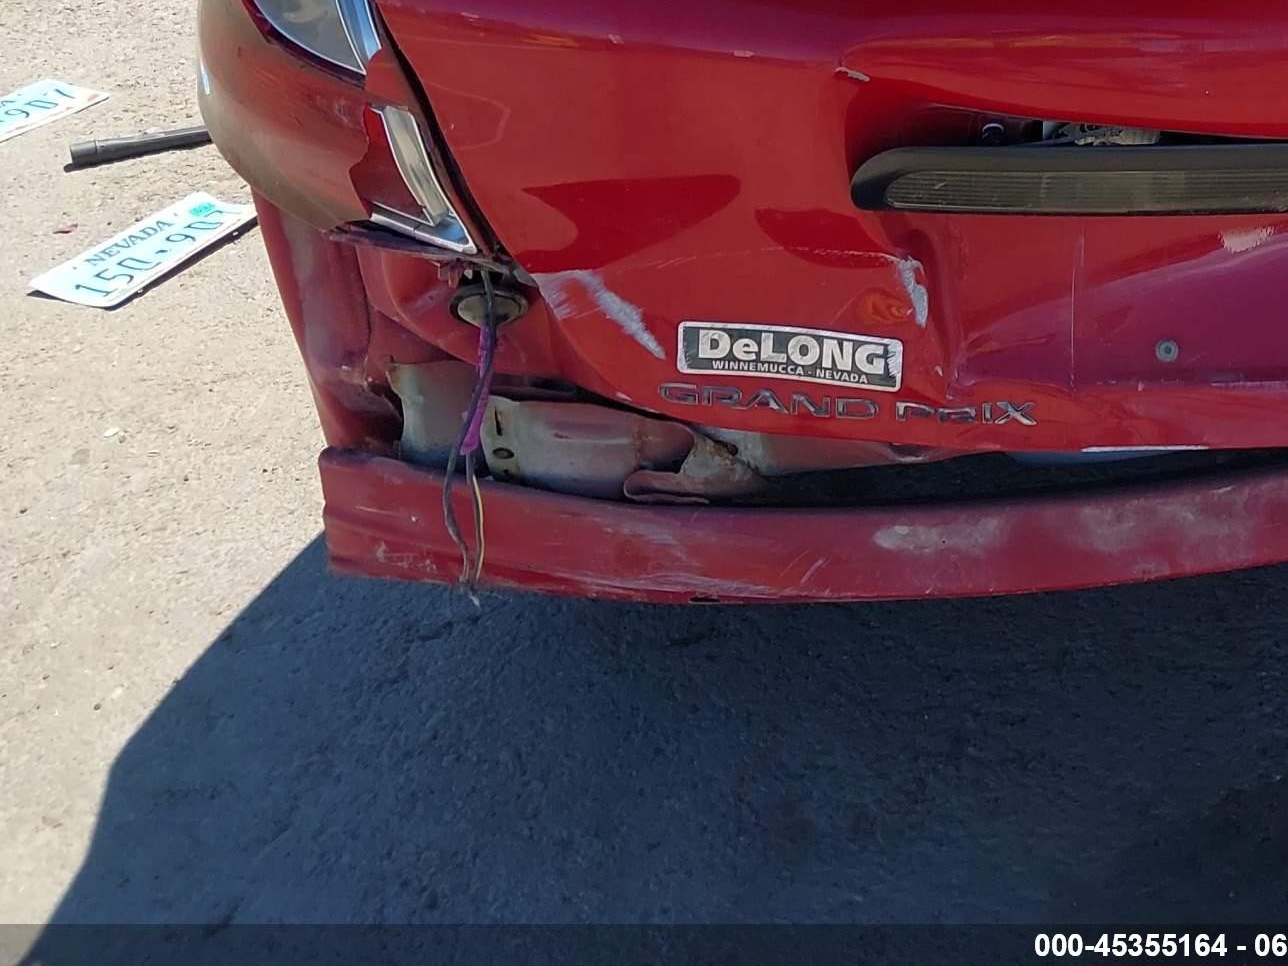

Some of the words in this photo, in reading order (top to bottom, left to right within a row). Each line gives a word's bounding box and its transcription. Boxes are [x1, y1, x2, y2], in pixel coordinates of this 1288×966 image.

[83, 219, 176, 266] NEVADA
[697, 329, 886, 375] DeLONG
[711, 360, 804, 376] WINNEMUCCA
[815, 368, 869, 384] NEVADA
[658, 382, 879, 419] GRAND
[896, 400, 1038, 426] PRIX
